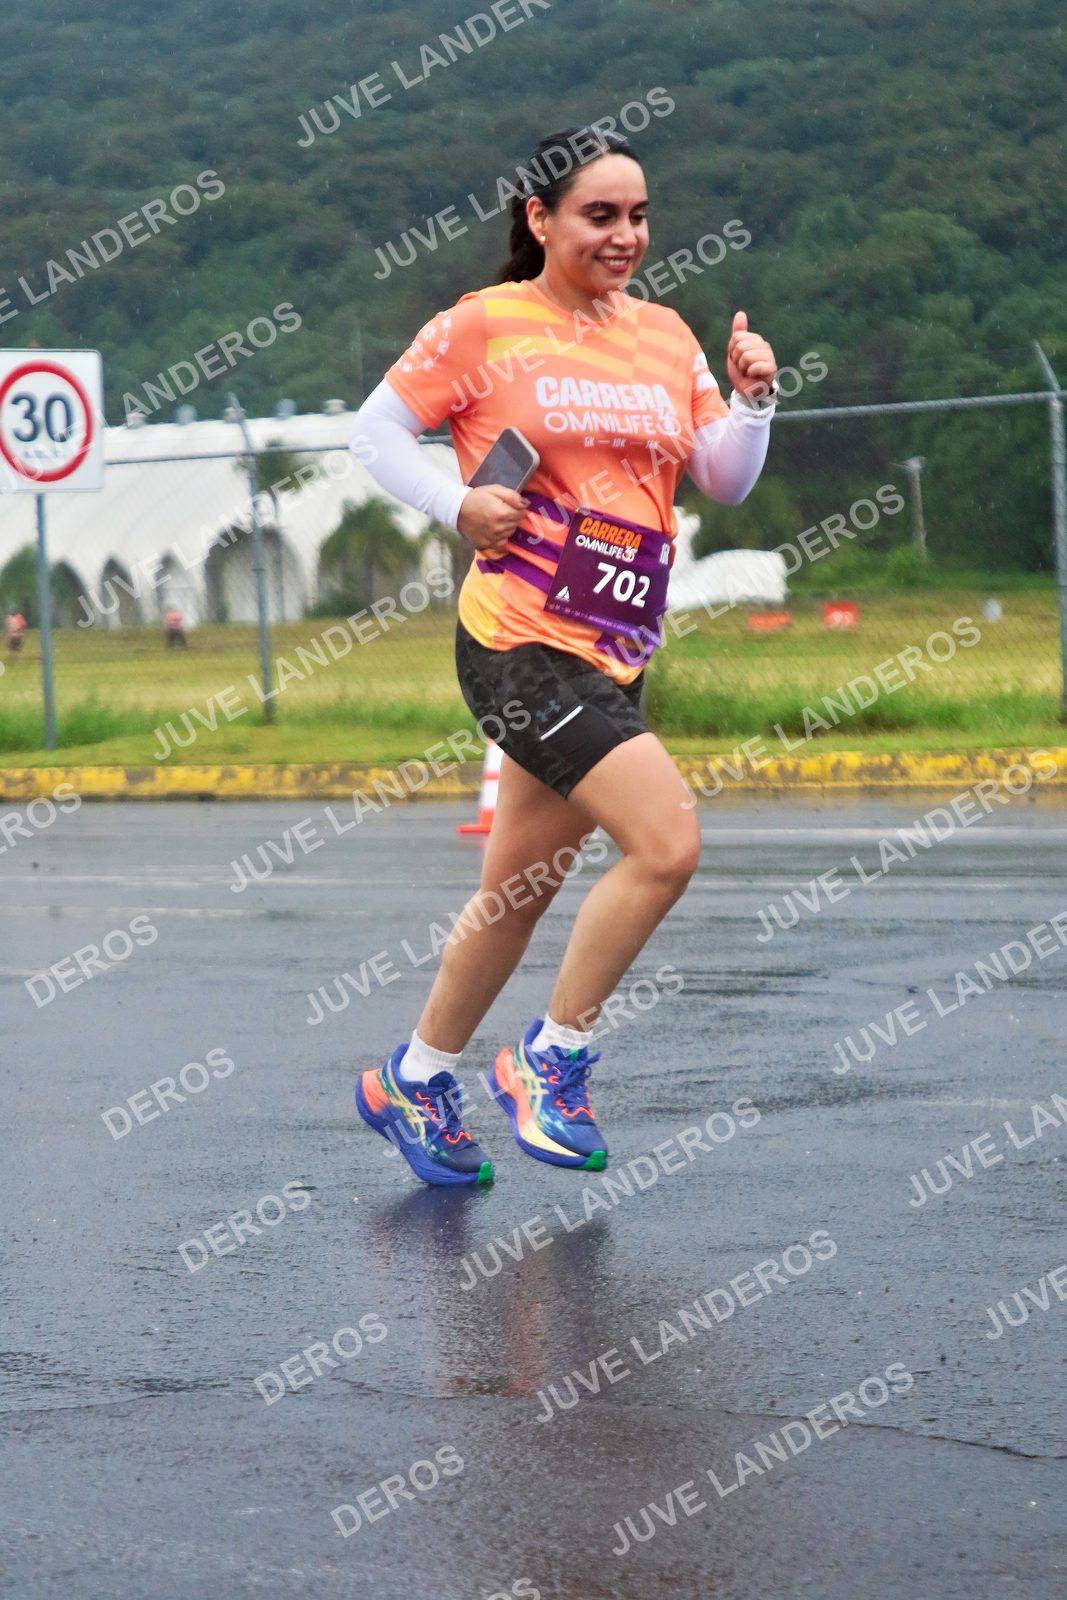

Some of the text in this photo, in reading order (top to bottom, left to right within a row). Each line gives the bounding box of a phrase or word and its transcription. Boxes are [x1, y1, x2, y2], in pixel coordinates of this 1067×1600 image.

[536, 376, 674, 412] CARRERA
[11, 392, 74, 442] 30
[544, 410, 657, 435] OMNILIFE
[575, 535, 623, 559] OMNILIFE
[580, 517, 643, 549] CARRERA
[593, 562, 650, 608] 702
